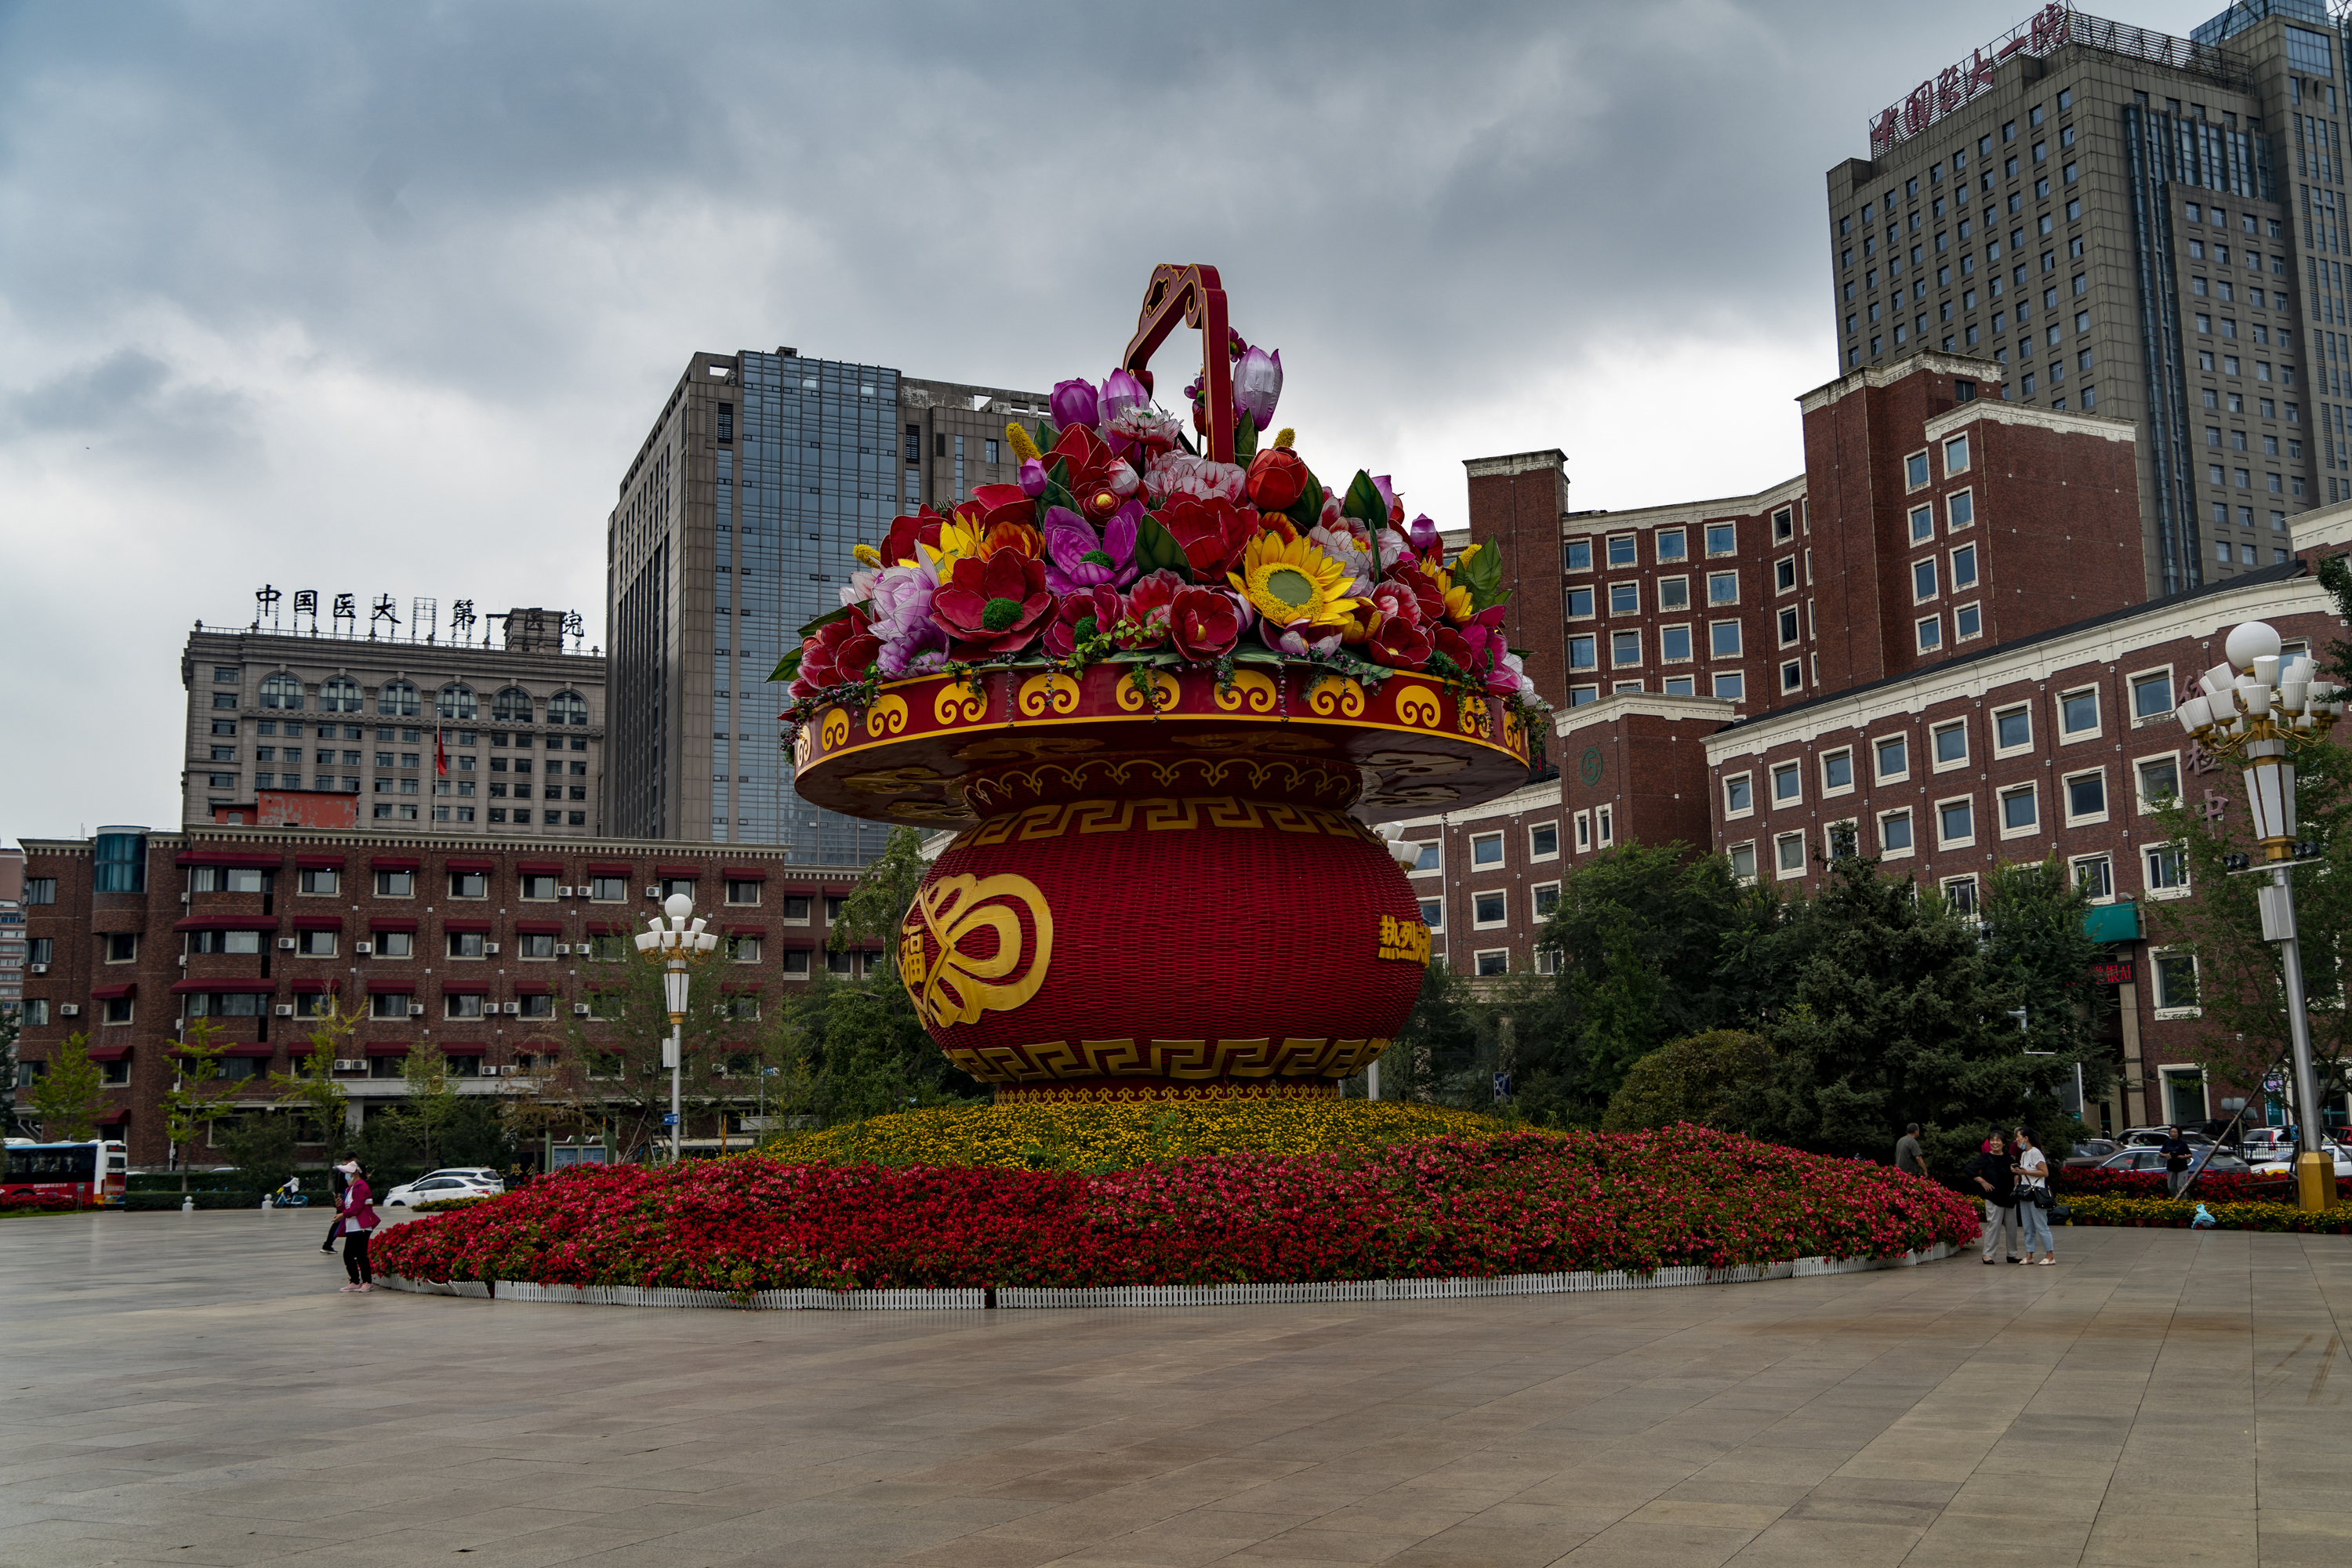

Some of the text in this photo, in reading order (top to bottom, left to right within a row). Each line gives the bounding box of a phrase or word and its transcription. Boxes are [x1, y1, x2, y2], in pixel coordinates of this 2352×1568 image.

[256, 583, 586, 637] 中国医大 第一医院
[901, 924, 927, 986] 福
